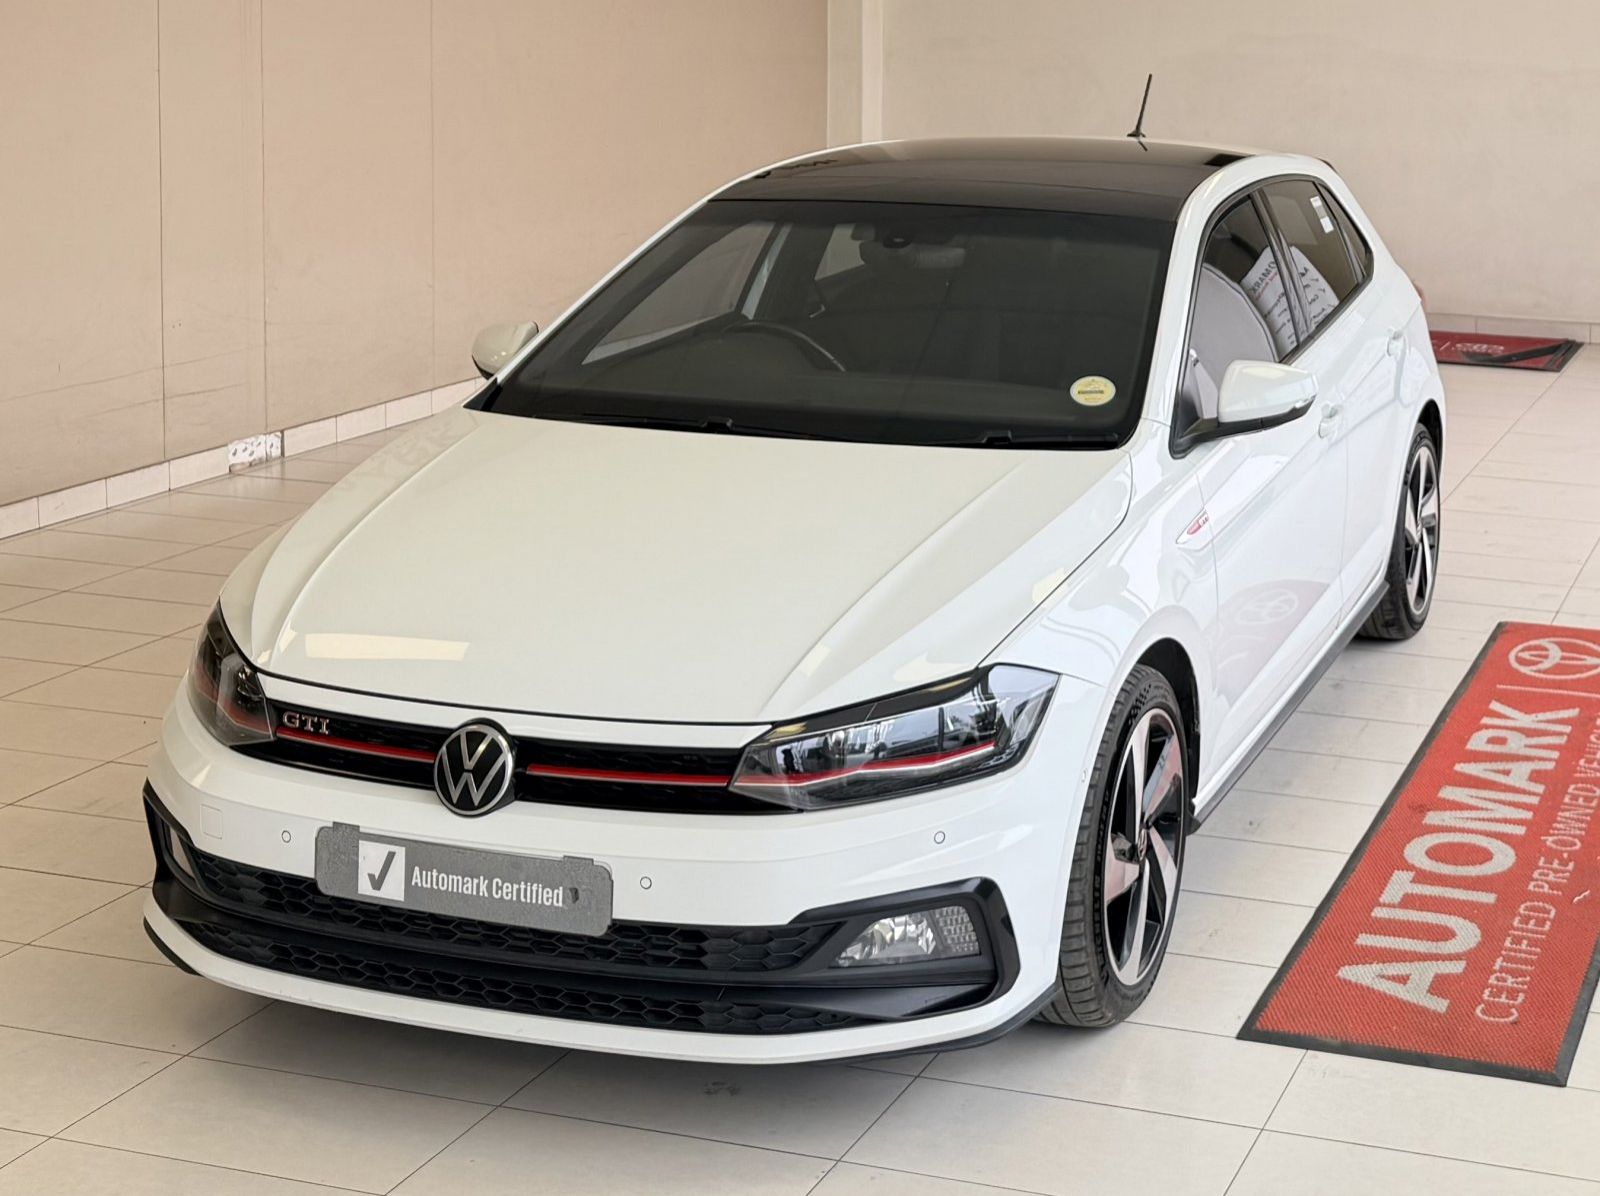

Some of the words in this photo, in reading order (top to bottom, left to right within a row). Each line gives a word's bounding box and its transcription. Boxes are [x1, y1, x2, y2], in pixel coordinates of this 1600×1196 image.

[283, 711, 329, 734] GTI
[411, 866, 488, 897] Automark
[492, 878, 563, 906] Certified
[1335, 699, 1581, 1014] AUTOMARK
[1476, 902, 1556, 1025] CERTIFIED
[1528, 783, 1598, 895] PRE-OWNED
